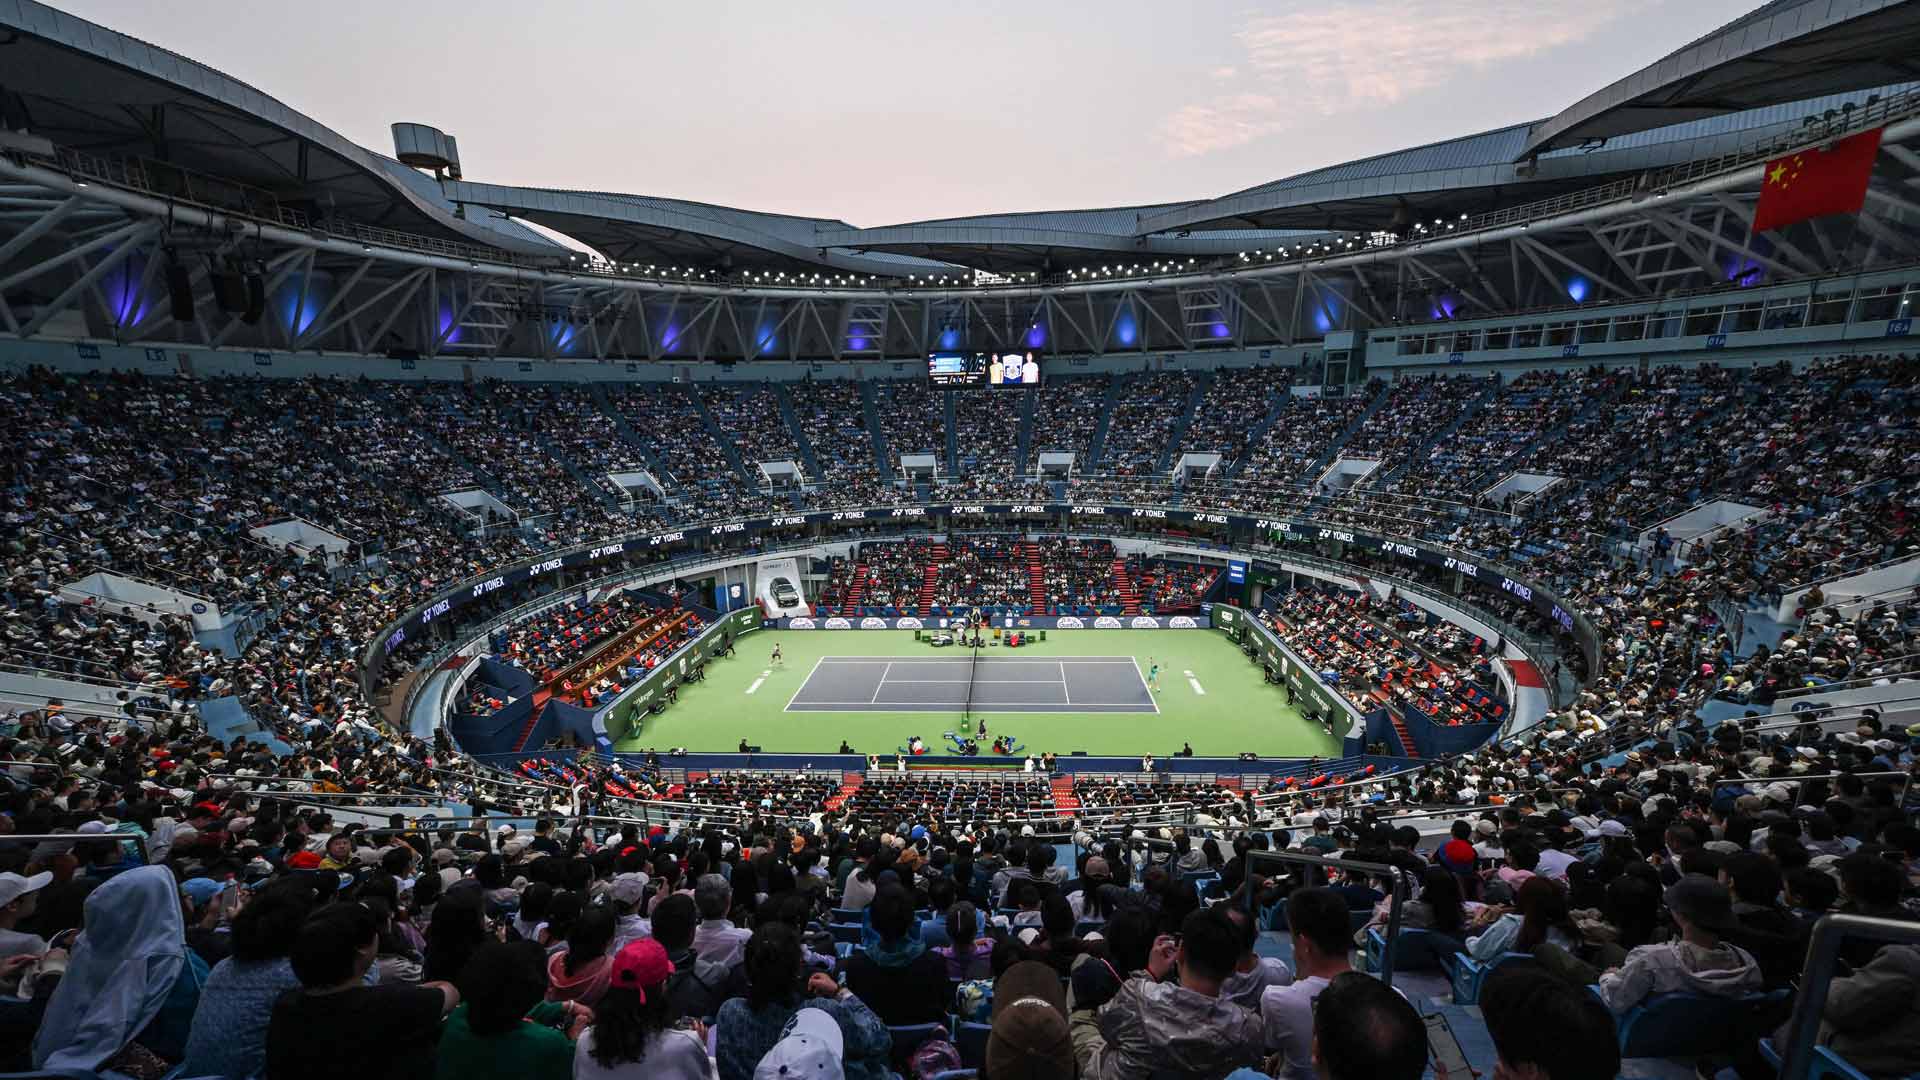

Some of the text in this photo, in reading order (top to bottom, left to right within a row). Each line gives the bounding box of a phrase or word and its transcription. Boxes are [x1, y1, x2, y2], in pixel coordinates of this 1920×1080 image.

[844, 511, 865, 520] YONEX
[904, 508, 925, 516] YONEX
[1084, 507, 1105, 515] YONEX
[1145, 510, 1166, 518] YONEX
[785, 516, 806, 526] YONEX
[1206, 514, 1228, 524] YONEX
[723, 523, 744, 534] YONEX
[1269, 521, 1291, 532] YONEX
[663, 532, 684, 543] YONEX
[1332, 532, 1355, 543] YONEX
[601, 543, 623, 555] YONEX
[1396, 544, 1418, 558] YONEX
[542, 557, 563, 572] YONEX
[1457, 560, 1478, 577] YONEX
[484, 576, 505, 592] YONEX
[1514, 584, 1533, 601] YONEX
[431, 598, 450, 617] YONEX
